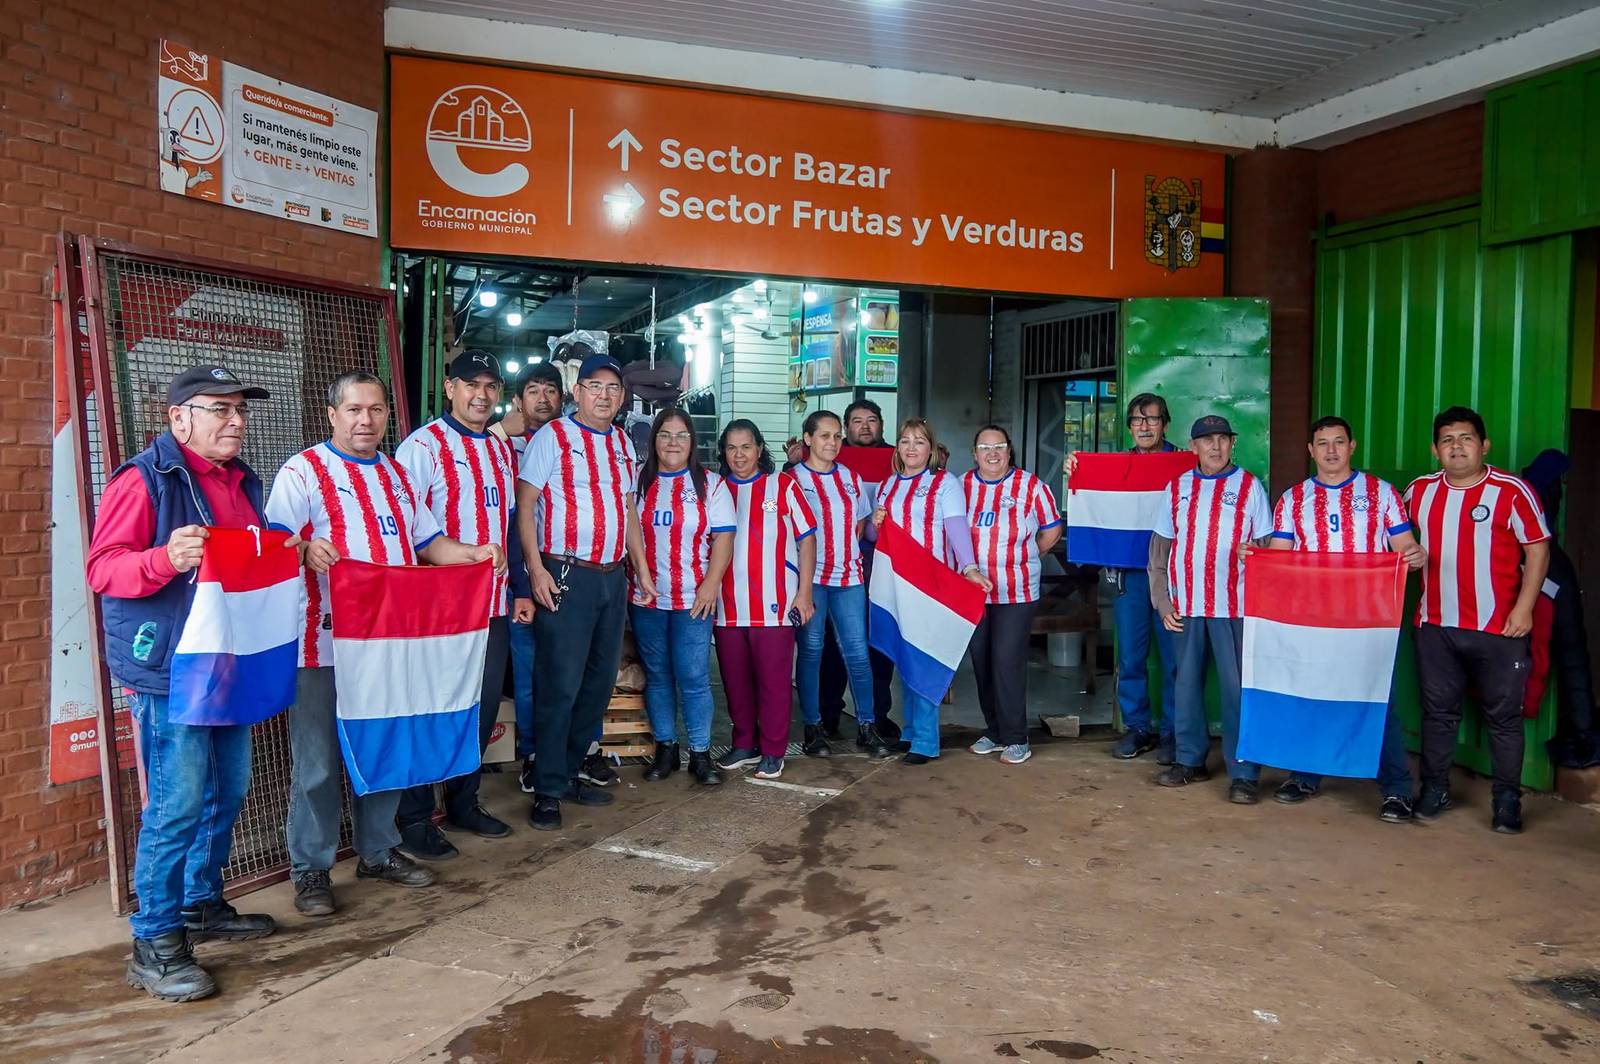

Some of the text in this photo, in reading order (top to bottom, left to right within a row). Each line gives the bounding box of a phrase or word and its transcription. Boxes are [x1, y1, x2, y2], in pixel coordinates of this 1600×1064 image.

[243, 112, 362, 158] Si mantenés limpio este
[243, 128, 359, 171] lugar, más gente viene.
[253, 149, 293, 170] GENTE
[313, 166, 356, 187] VENTAS
[659, 138, 891, 189] Sector Bazar
[418, 199, 536, 225] Encarnación
[658, 187, 1084, 253] Sector Frutas y Verduras
[421, 219, 533, 235] GOBIERNO MUNICIPAL
[483, 485, 499, 508] 10
[378, 514, 398, 536] 19
[653, 510, 673, 527] 10
[976, 511, 995, 527] 10
[1328, 512, 1340, 533] 9
